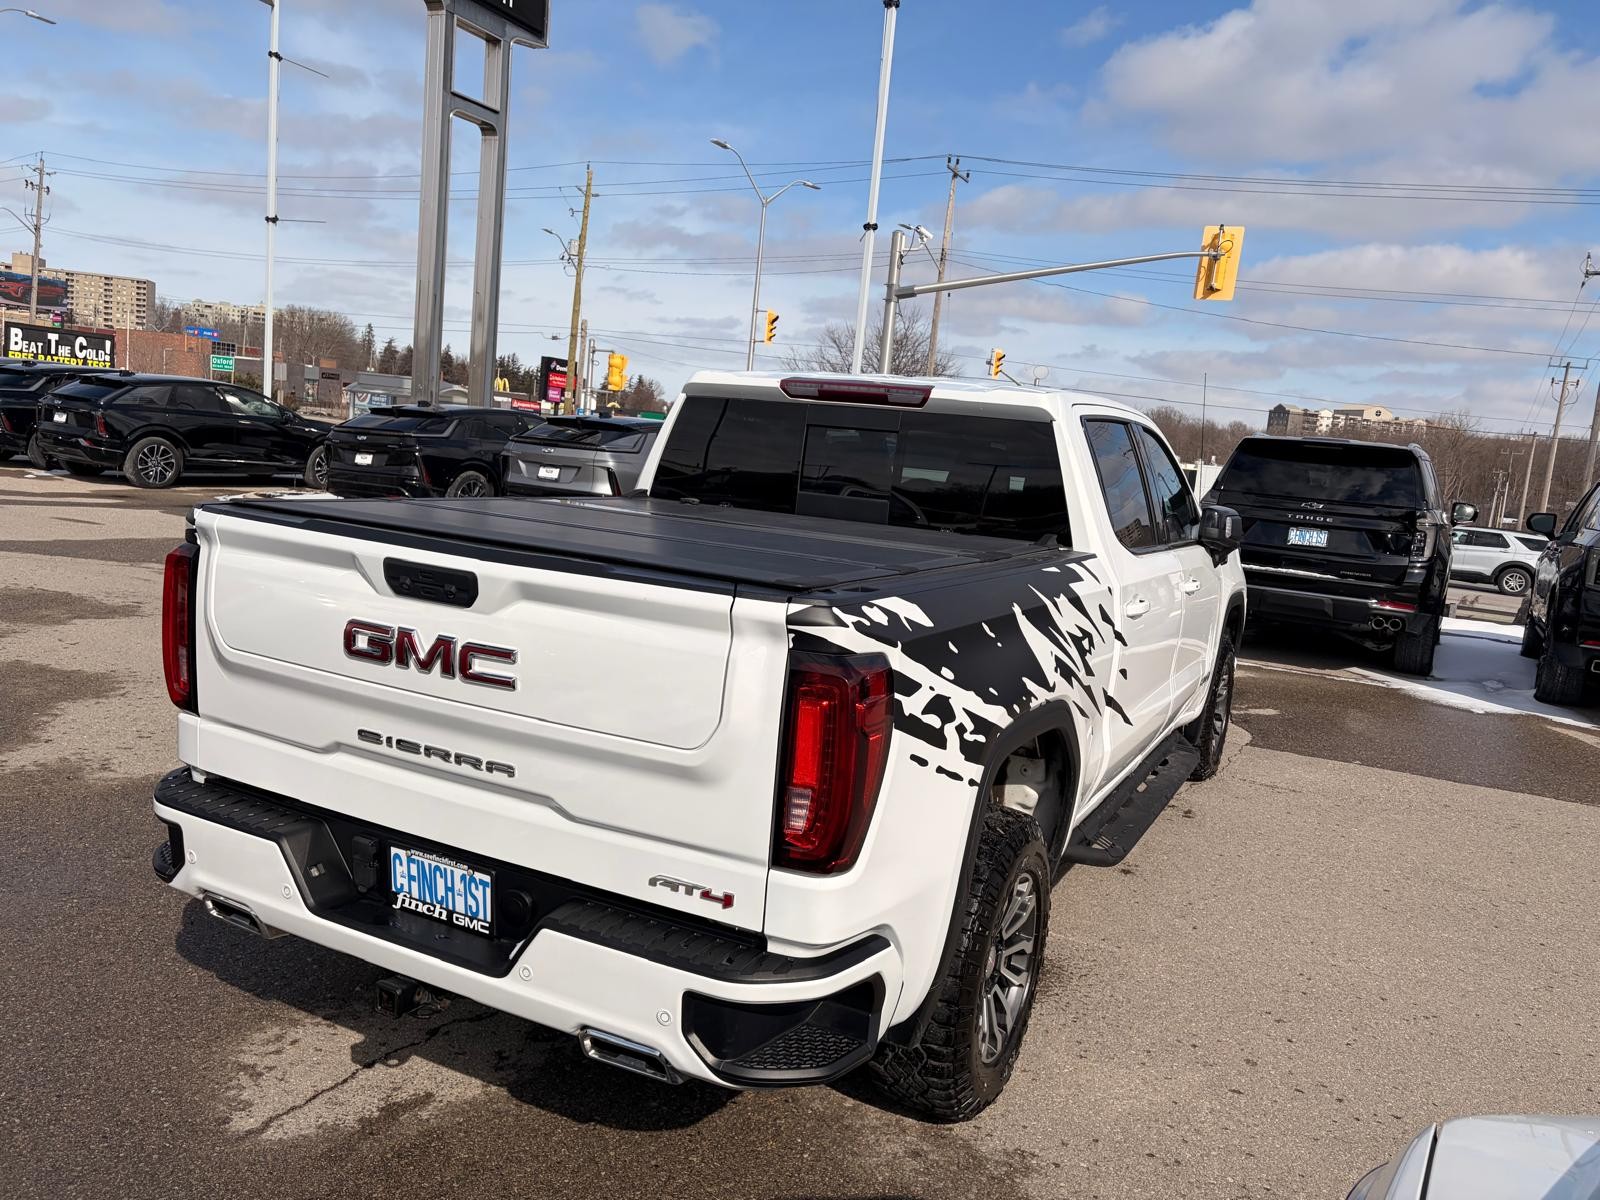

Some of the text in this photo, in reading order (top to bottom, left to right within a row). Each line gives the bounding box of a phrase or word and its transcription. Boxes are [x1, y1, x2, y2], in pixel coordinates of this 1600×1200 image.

[212, 357, 232, 366] Oxford
[1287, 512, 1333, 523] TAHOE
[343, 618, 519, 691] GMC
[357, 728, 516, 778] SIERRA
[410, 848, 469, 871] www.seefinchfirst.com
[648, 874, 735, 910] AT4
[391, 892, 490, 934] finch GMC
